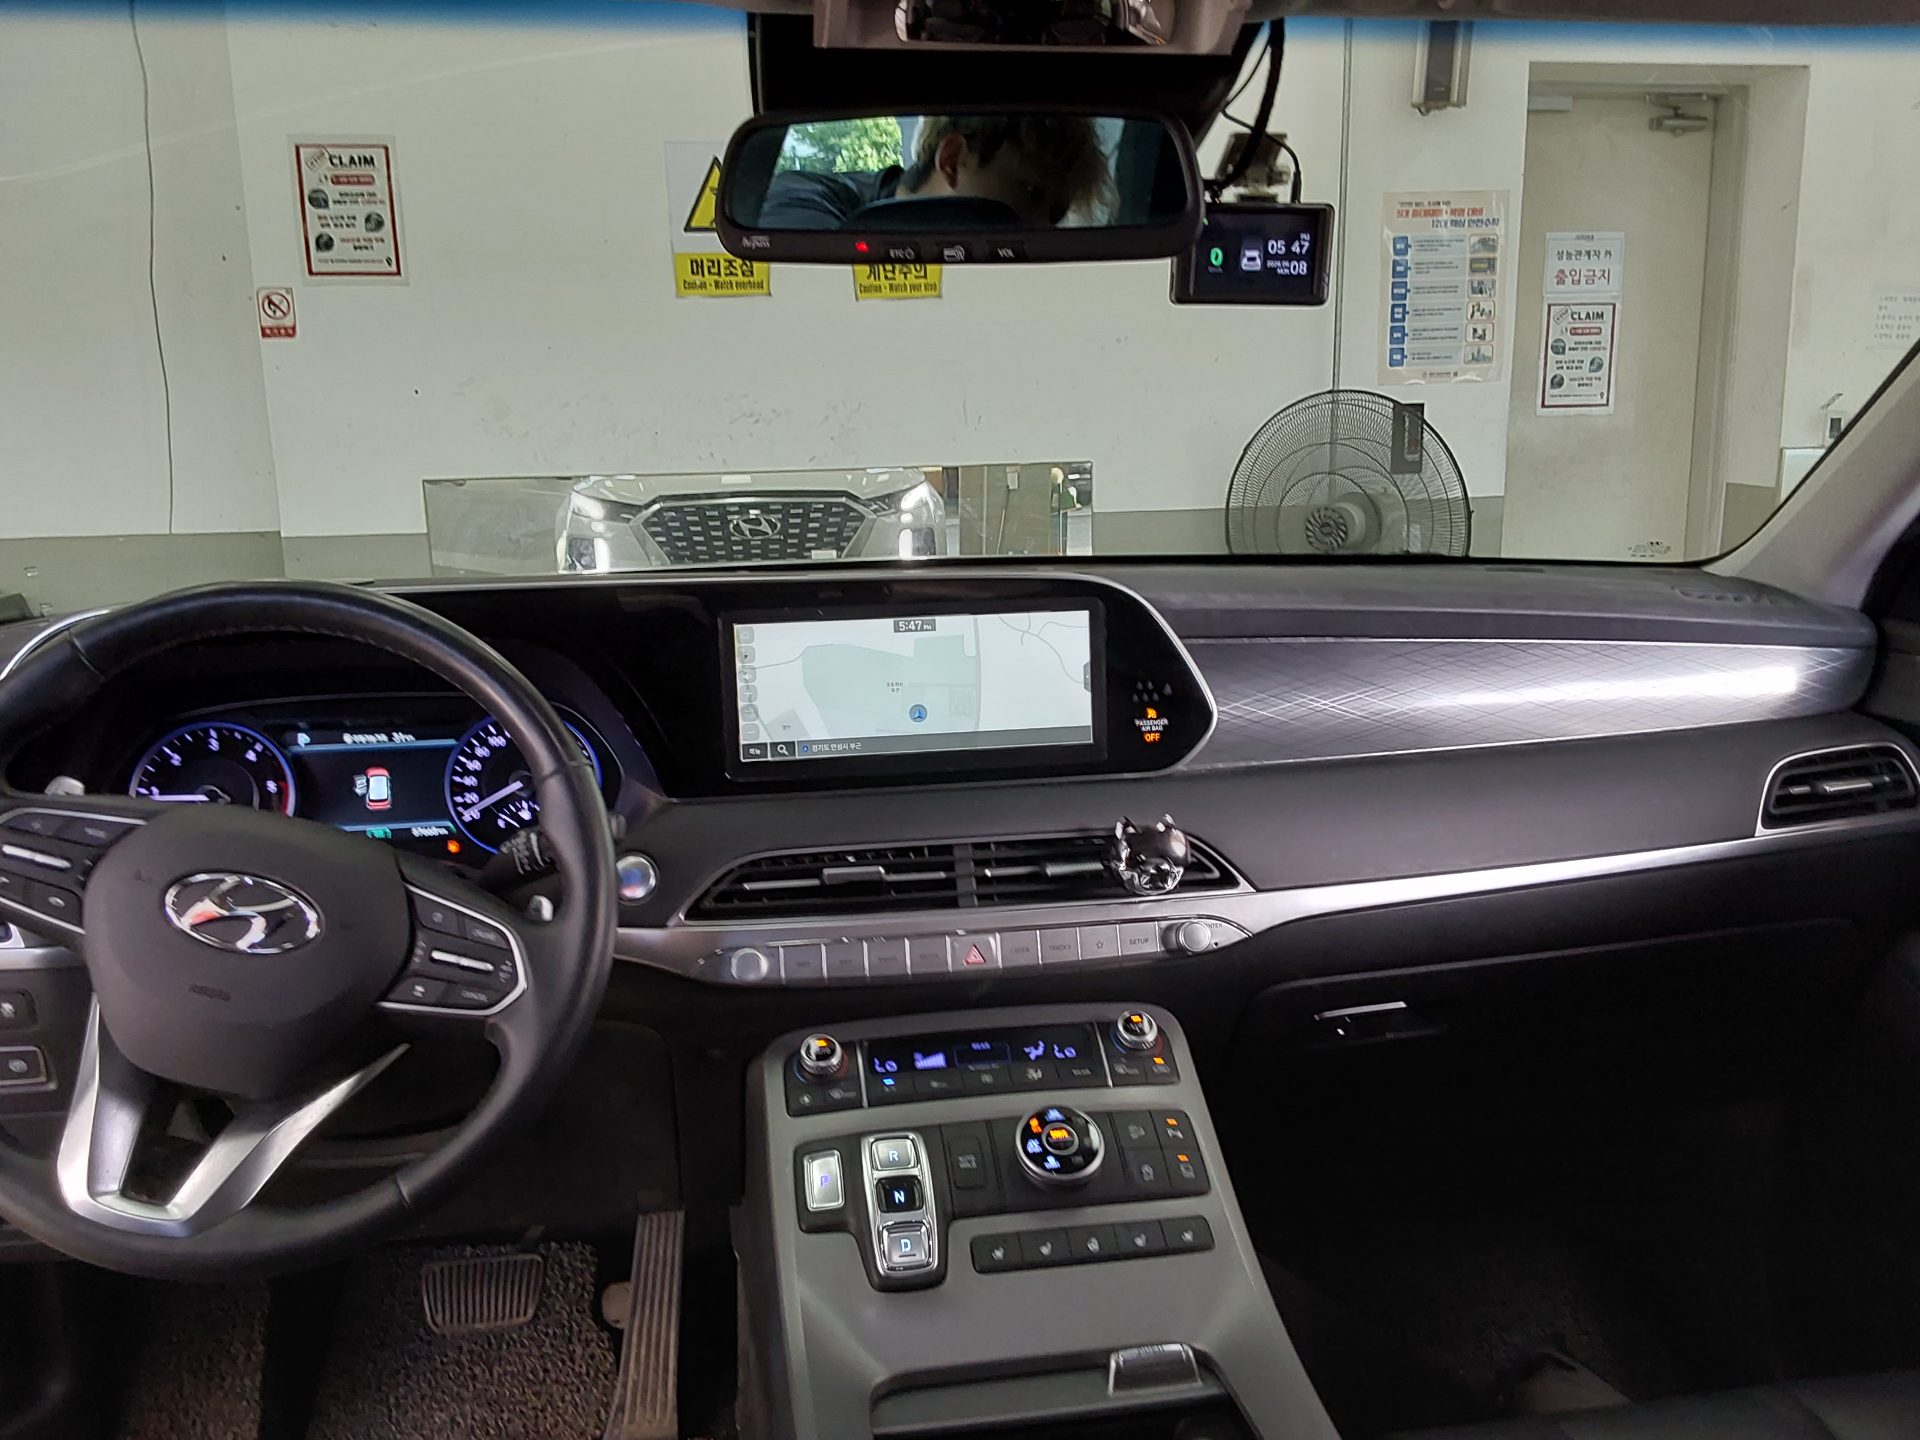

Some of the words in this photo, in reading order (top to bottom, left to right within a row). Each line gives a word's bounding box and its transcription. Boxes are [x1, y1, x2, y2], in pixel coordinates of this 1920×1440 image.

[328, 154, 376, 168] CLAIM
[1267, 239, 1286, 255] 05
[1291, 239, 1310, 255] 47
[1210, 247, 1223, 267] 0
[1557, 249, 1601, 261] 성능관계자
[690, 257, 755, 278] 머리조심
[867, 264, 928, 282] 계단주의
[1290, 260, 1307, 275] 08
[1554, 268, 1611, 286] 출입금지
[1570, 311, 1605, 321] CLAIM
[899, 620, 922, 631] 5:47
[1134, 717, 1169, 727] PASSENGER
[1144, 732, 1161, 743] OFF
[811, 743, 830, 752] 경기도
[849, 742, 862, 750] 부근
[1129, 938, 1149, 946] SETUP
[888, 1149, 899, 1162] R
[820, 1175, 831, 1188] P
[894, 1190, 905, 1204] N
[900, 1238, 911, 1252] D
